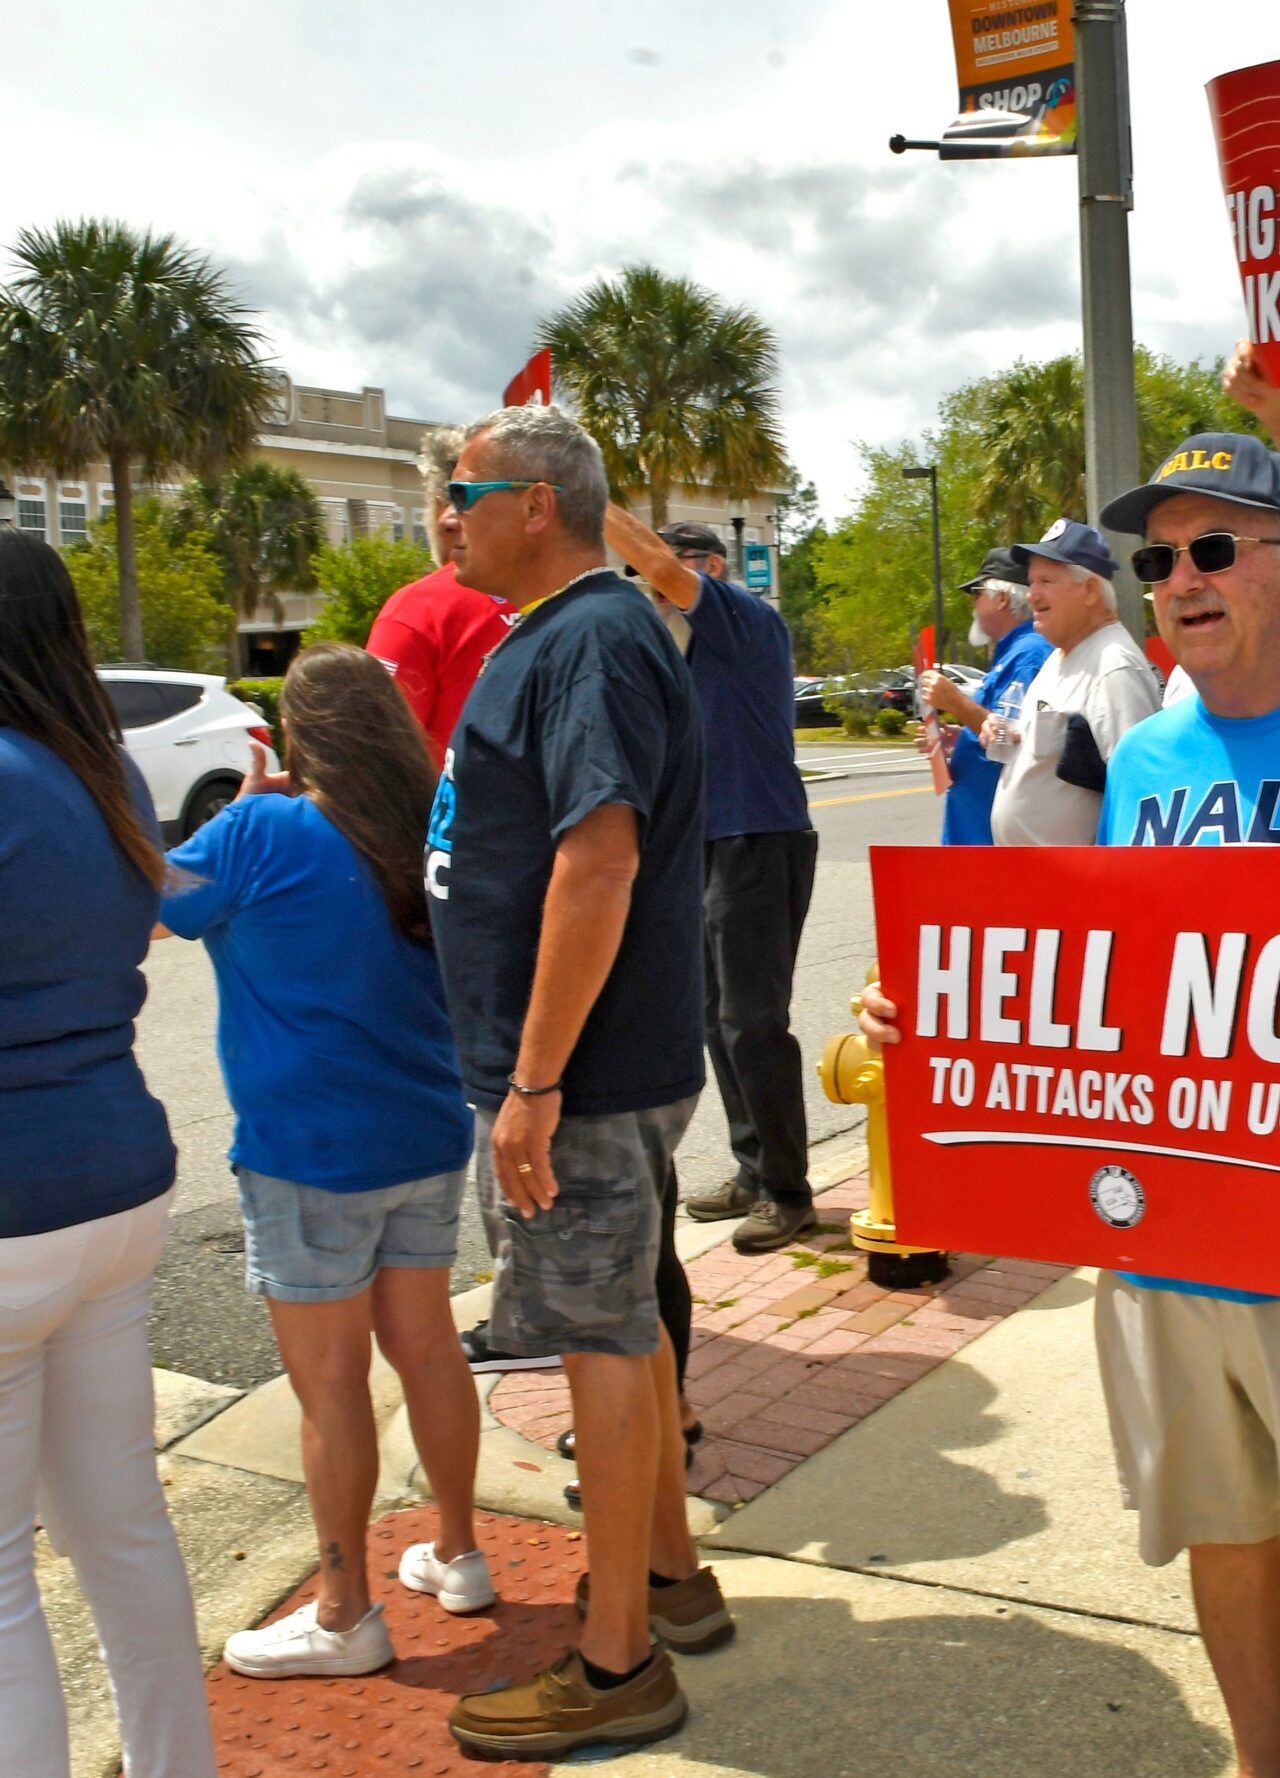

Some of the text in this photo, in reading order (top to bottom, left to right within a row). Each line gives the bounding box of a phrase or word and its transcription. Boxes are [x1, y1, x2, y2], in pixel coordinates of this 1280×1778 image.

[972, 1, 1058, 34] DOWNTOWN
[973, 20, 1058, 54] MELBOURNE
[978, 83, 1042, 112] SHOP
[916, 924, 1122, 1052] HELL
[929, 1056, 976, 1107] TO
[985, 1062, 1154, 1125] ATTACKS
[1167, 1076, 1232, 1132] ON
